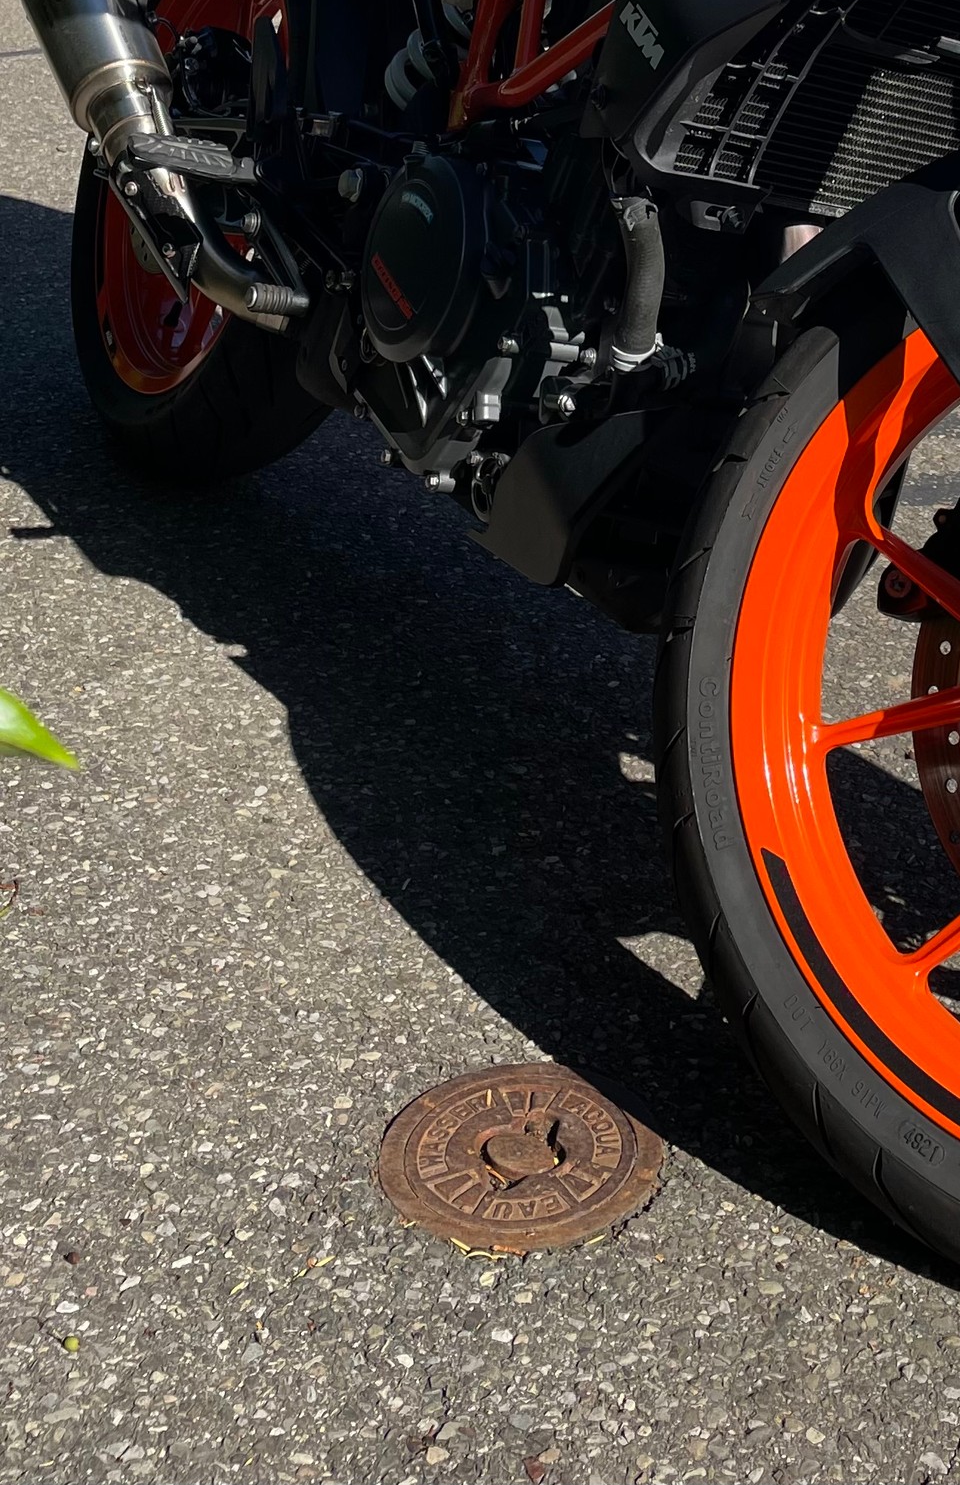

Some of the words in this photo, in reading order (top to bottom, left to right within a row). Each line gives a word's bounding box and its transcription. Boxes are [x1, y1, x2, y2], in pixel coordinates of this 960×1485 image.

[619, 0, 665, 71] KTM
[756, 447, 785, 490] FRONT
[698, 675, 735, 852] ContiRoad
[783, 993, 815, 1032] DOT
[566, 1099, 622, 1159] ACQUA
[492, 1193, 567, 1221] EAU
